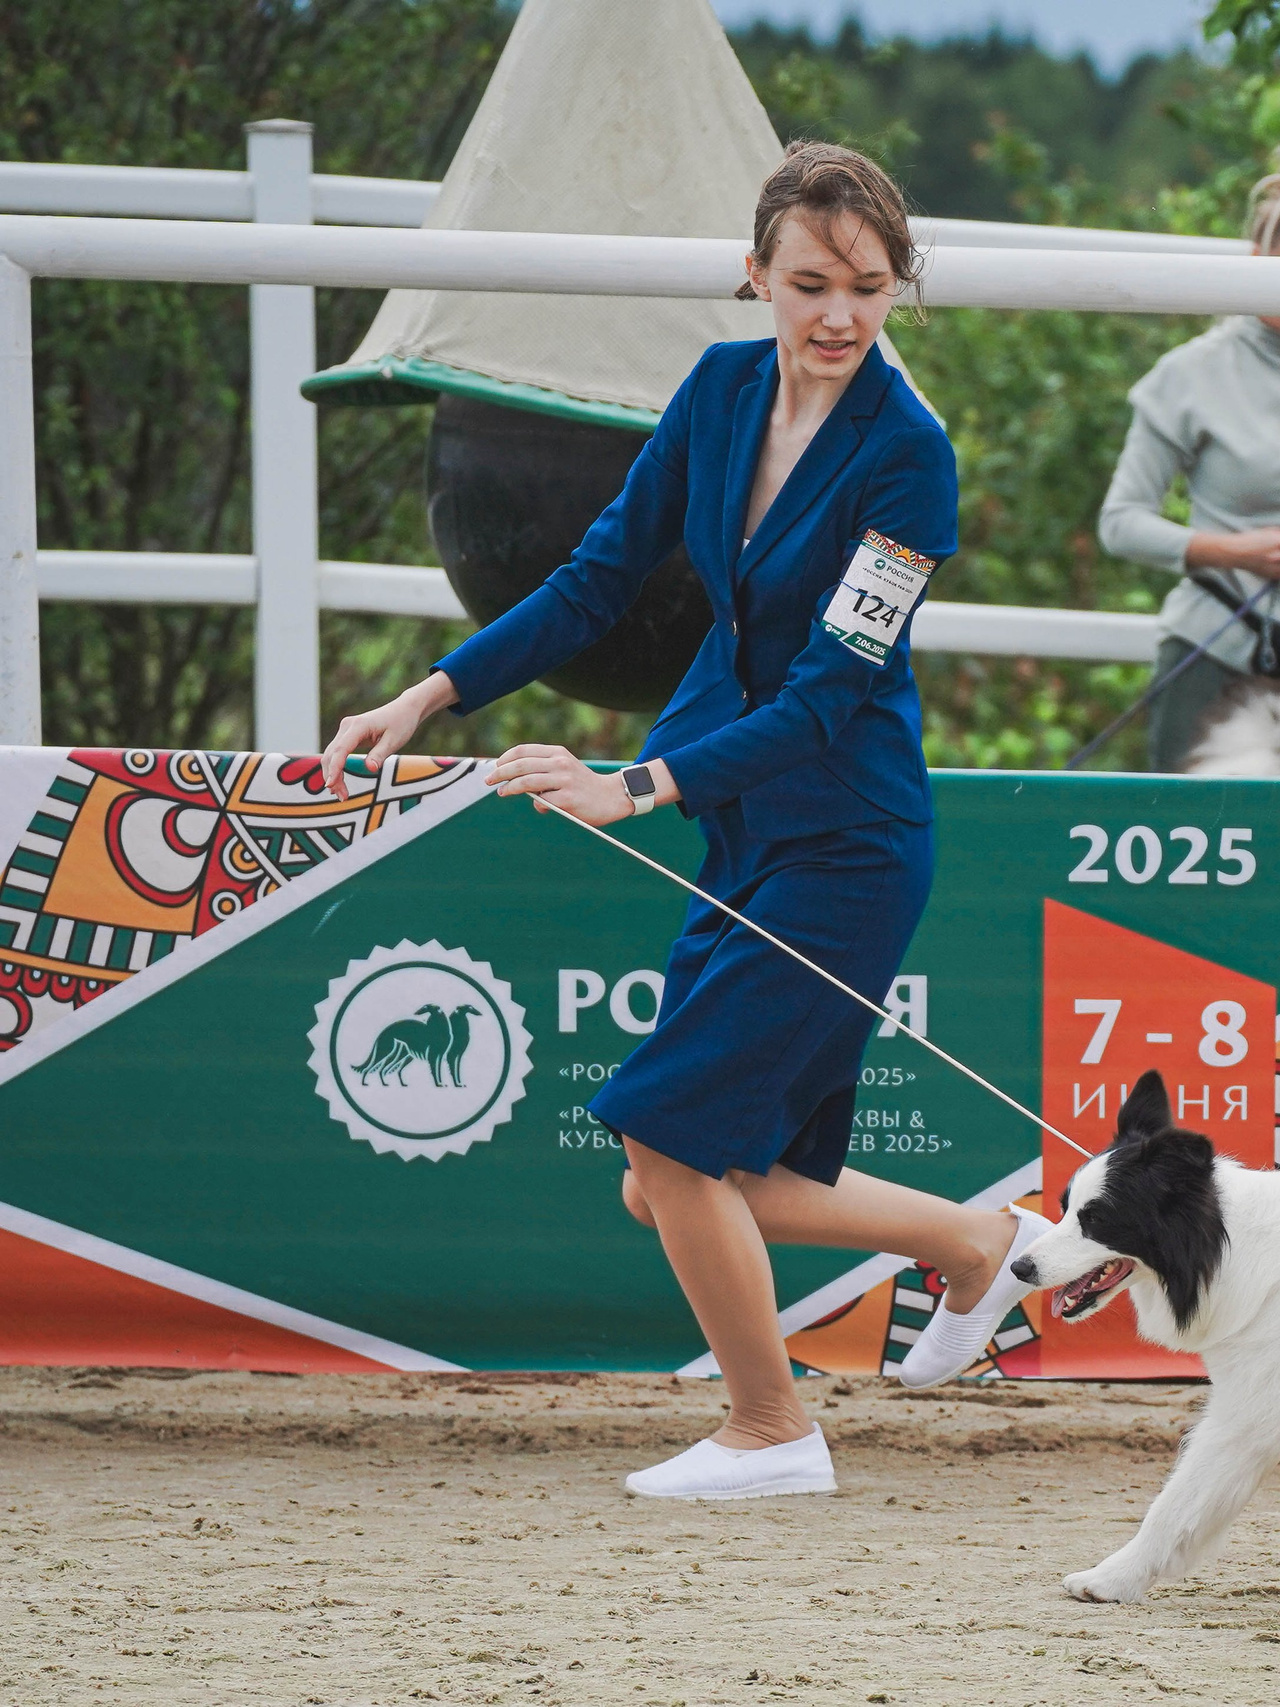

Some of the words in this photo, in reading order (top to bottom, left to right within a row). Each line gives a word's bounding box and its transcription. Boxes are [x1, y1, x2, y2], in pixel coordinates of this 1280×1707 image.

[852, 588, 899, 628] 124
[855, 636, 886, 656] 7.06.2025
[1068, 824, 1257, 886] 2025
[1074, 998, 1122, 1064] 7
[1198, 1000, 1249, 1067] 8
[1073, 1083, 1248, 1121] ИНЯ
